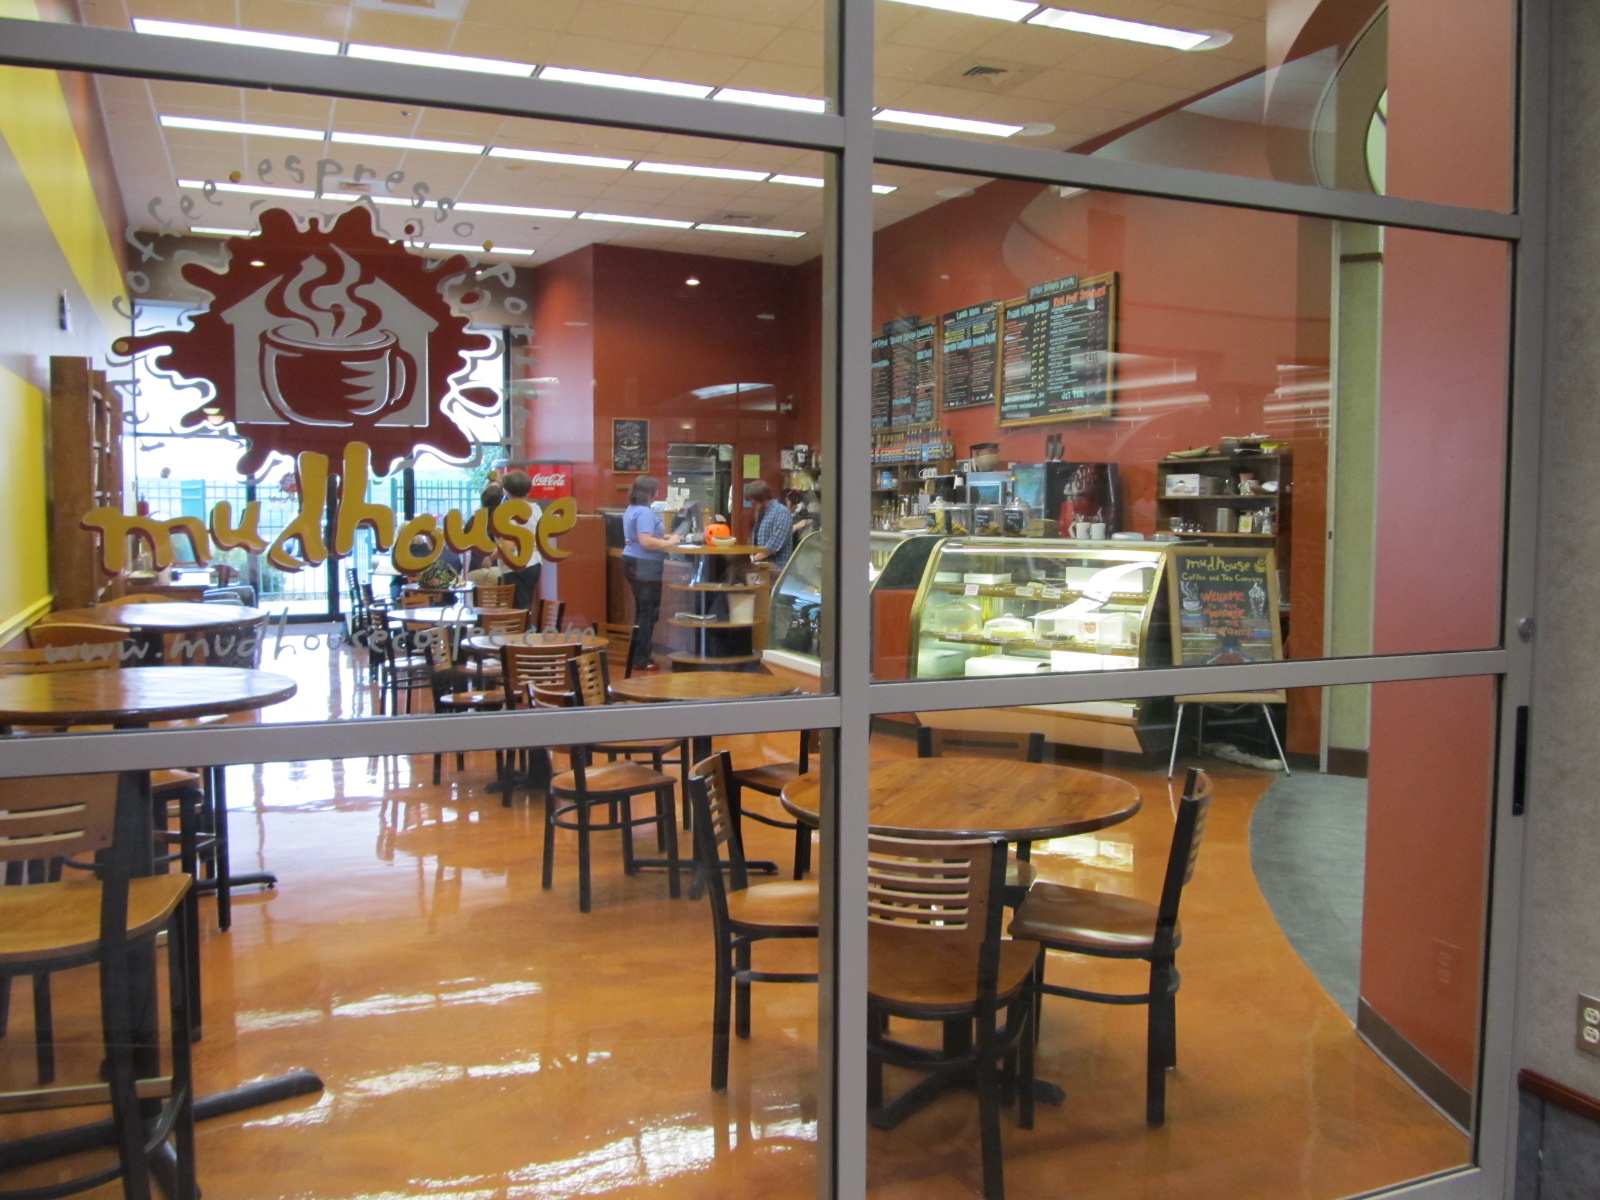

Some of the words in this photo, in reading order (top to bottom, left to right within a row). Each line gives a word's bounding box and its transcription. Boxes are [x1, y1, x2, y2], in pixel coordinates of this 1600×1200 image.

[112, 178, 223, 321] coffee
[257, 155, 475, 238] espresso
[79, 441, 579, 575] mudhouse
[1186, 556, 1251, 571] mudhouse
